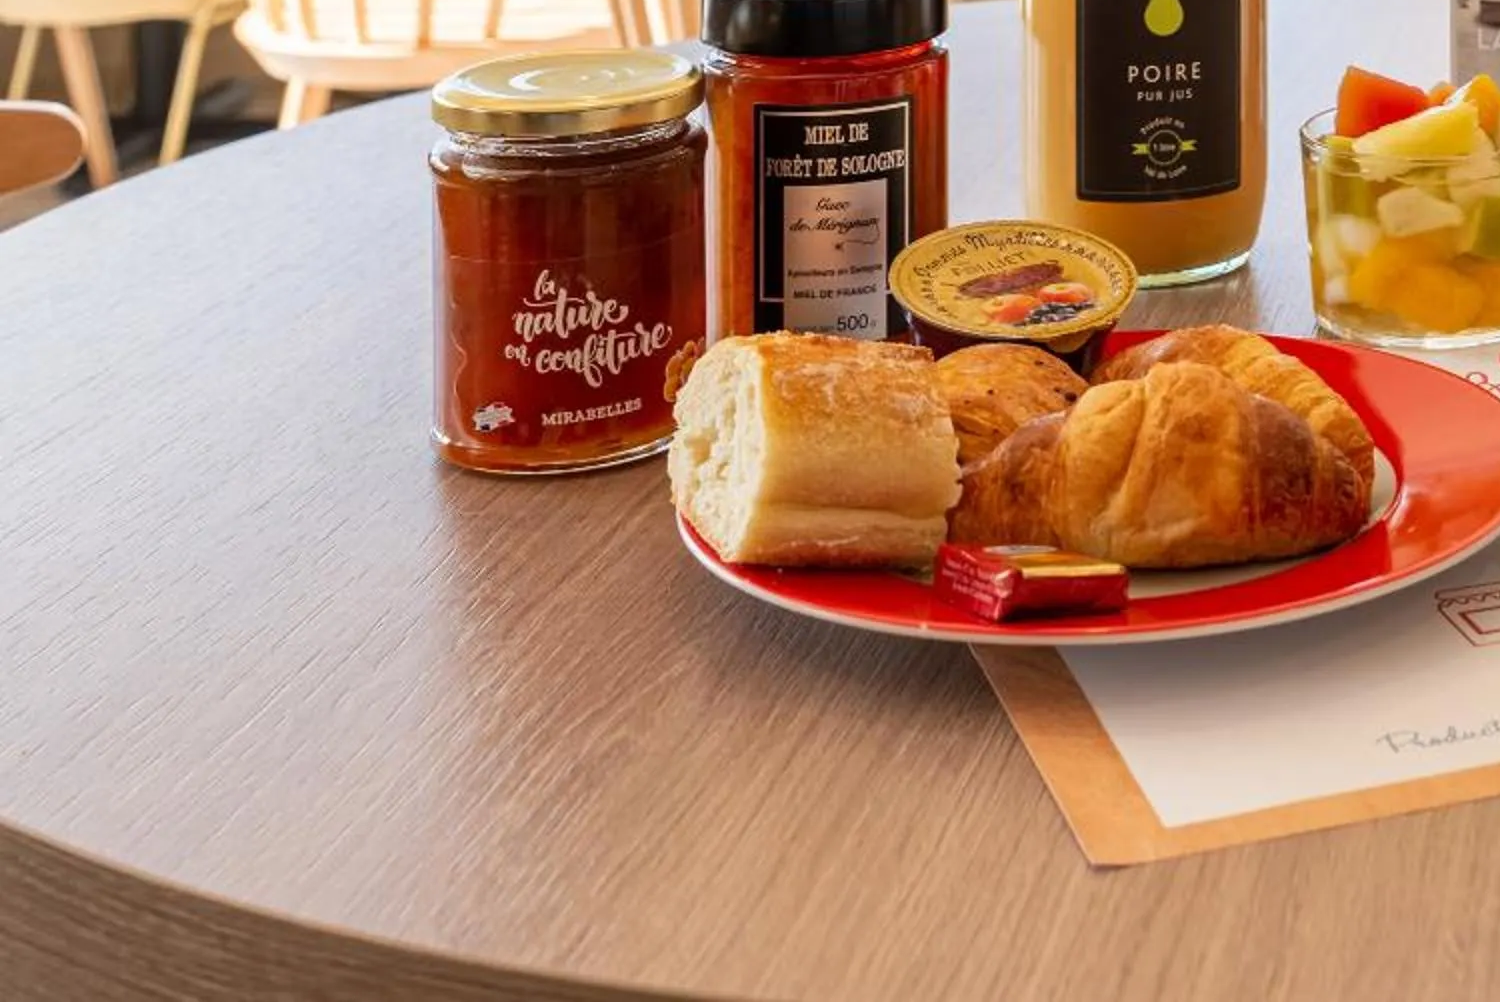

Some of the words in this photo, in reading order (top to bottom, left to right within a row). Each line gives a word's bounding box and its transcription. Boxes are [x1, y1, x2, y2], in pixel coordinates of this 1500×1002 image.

[1127, 61, 1201, 84] POIRE
[804, 125, 845, 145] MIEL
[848, 122, 869, 142] DE
[816, 157, 838, 177] DE
[841, 149, 905, 175] SOLOGNE
[534, 269, 556, 301] la
[512, 287, 629, 343] nature
[836, 313, 869, 332] 500
[504, 344, 531, 367] en
[535, 322, 673, 388] confiture
[541, 397, 643, 427] MIRABELLES
